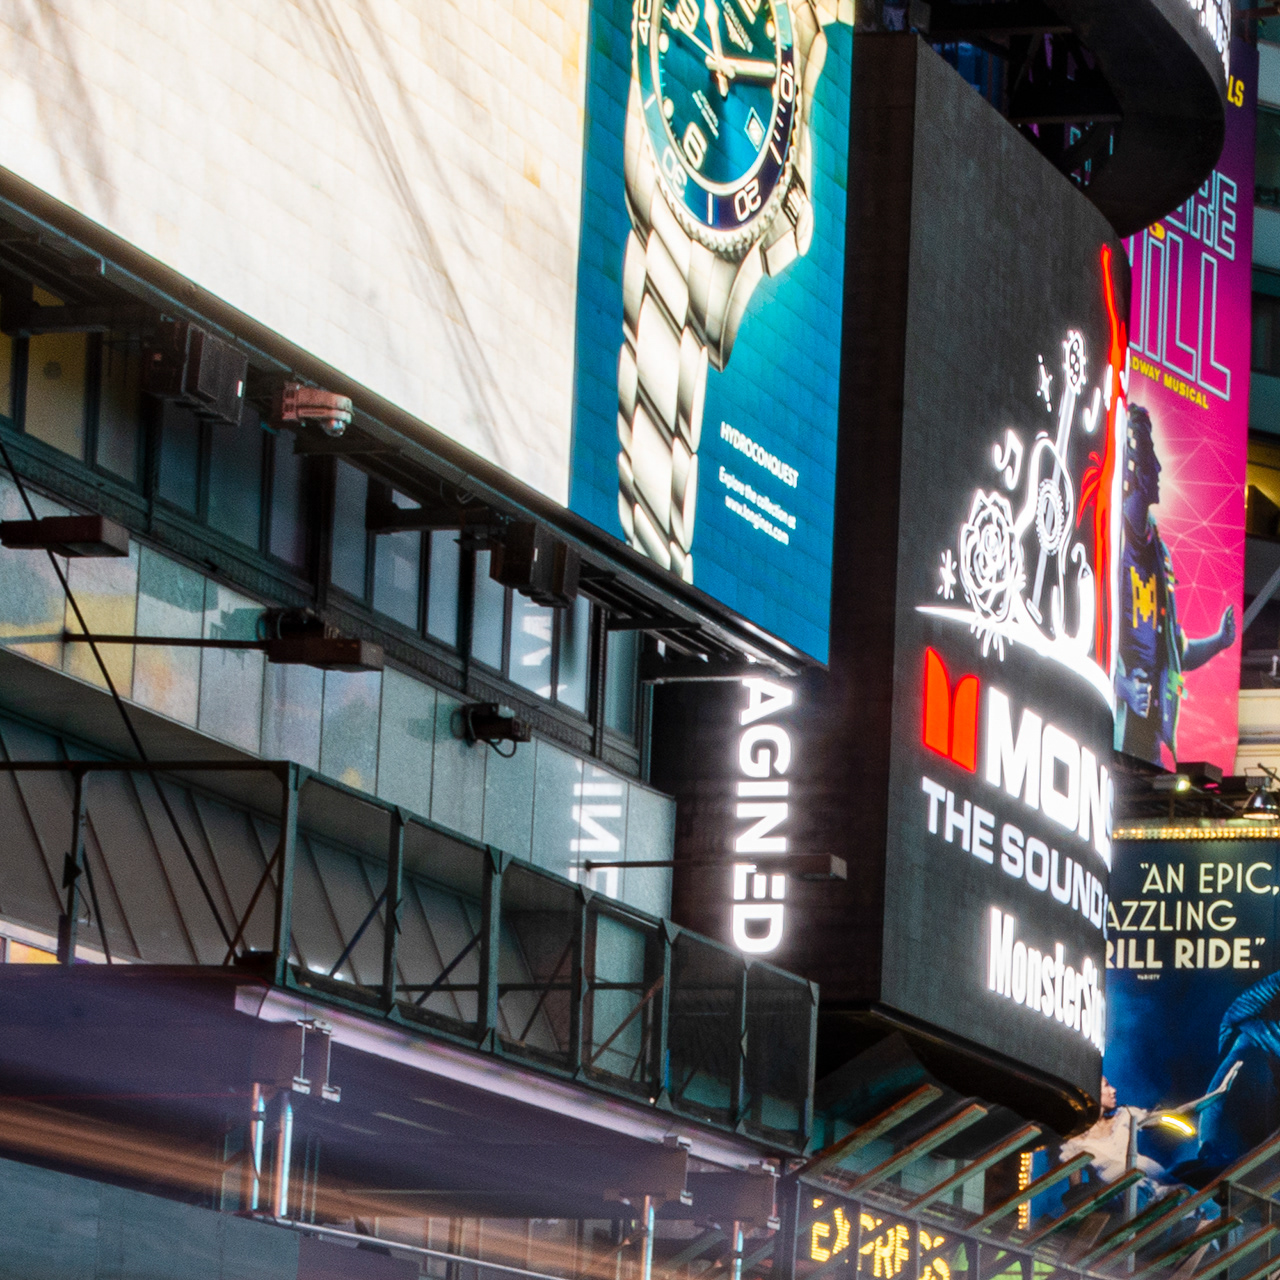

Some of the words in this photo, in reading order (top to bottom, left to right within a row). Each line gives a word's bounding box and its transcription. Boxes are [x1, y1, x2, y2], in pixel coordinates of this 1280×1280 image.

[1164, 373, 1209, 410] MUSICAL
[720, 421, 799, 489] HYDROCONQUEST
[921, 775, 995, 867] THE
[1001, 824, 1103, 931] SOUND
[1199, 862, 1280, 896] EPIC,
